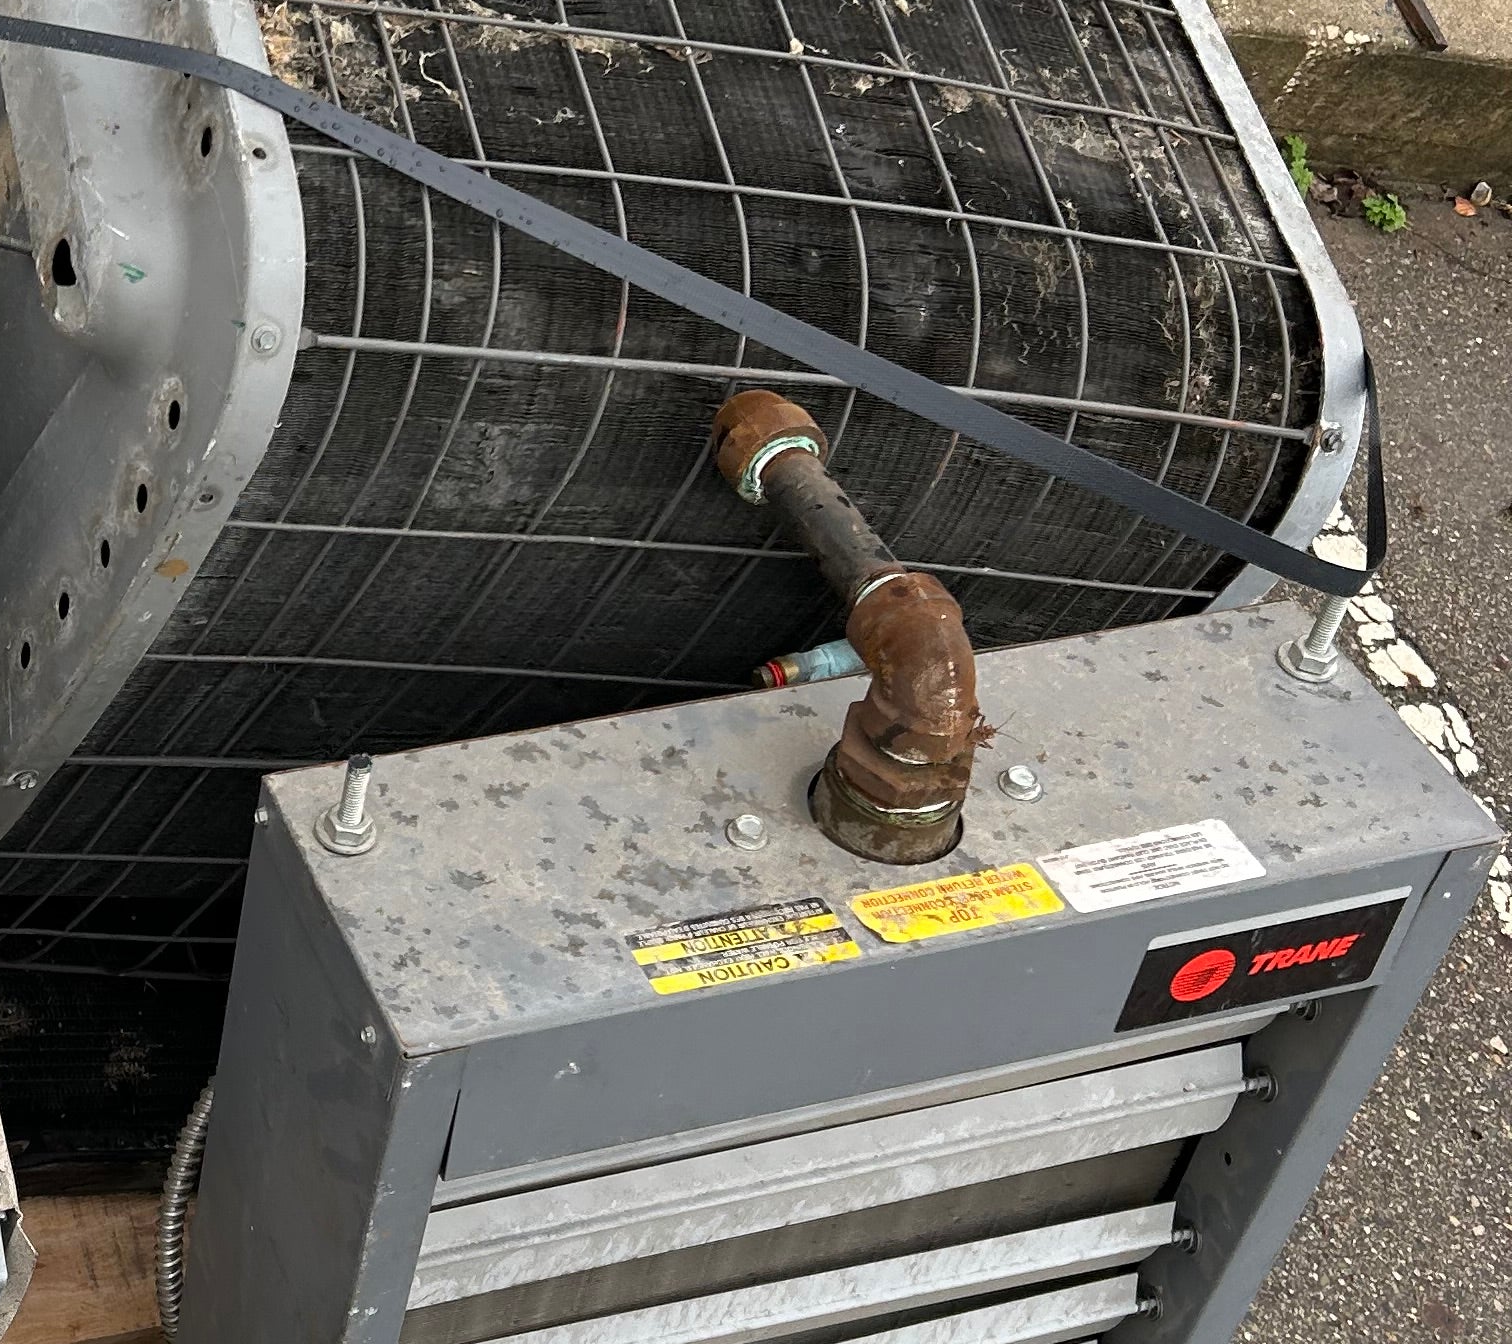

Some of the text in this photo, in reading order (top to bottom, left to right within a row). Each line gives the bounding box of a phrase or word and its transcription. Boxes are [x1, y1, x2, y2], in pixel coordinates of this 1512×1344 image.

[861, 870, 1025, 907] WATER RETURN CONNECTION
[992, 881, 1032, 896] STEAM
[949, 906, 981, 922] TOP
[681, 927, 768, 951] ATTENTION
[1248, 933, 1360, 976] TRANE
[698, 956, 789, 982] CAUTION
